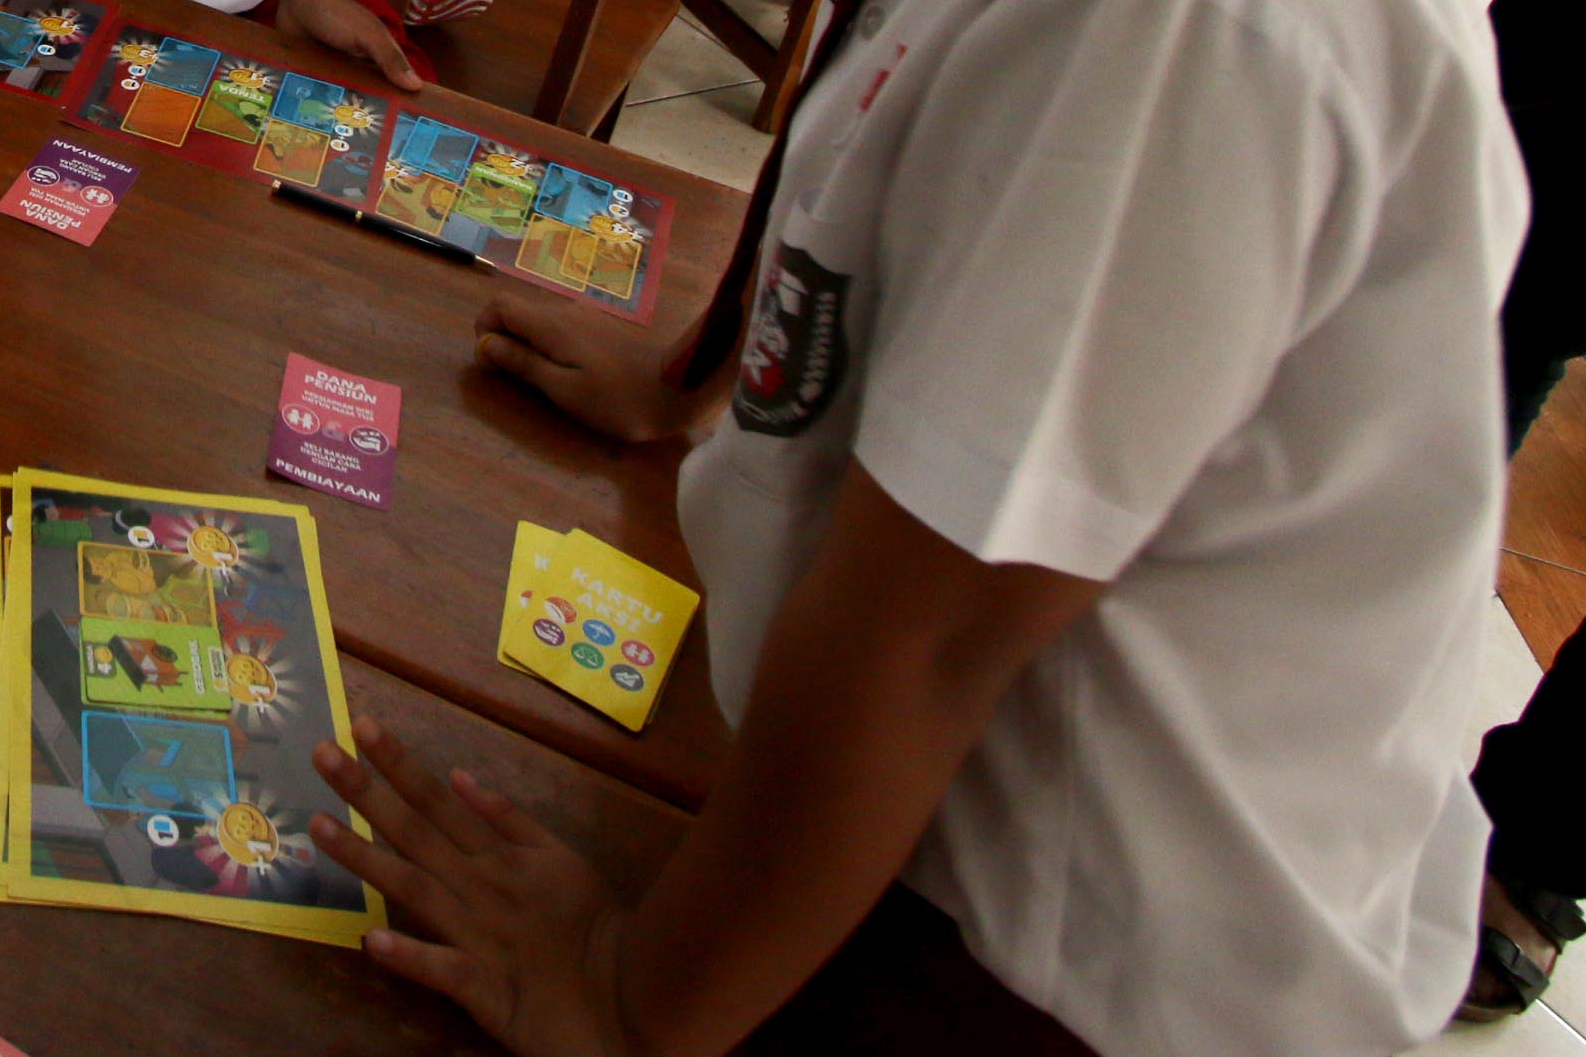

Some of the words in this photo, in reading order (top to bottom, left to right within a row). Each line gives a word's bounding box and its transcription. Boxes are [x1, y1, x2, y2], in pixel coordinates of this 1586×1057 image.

[215, 82, 267, 104] TENDA
[51, 139, 133, 173] PEMBIAYAAN
[17, 197, 83, 229] PENSIUN
[23, 206, 69, 230] DANA
[303, 373, 377, 406] PENSIUN
[316, 369, 366, 394] DANA
[274, 457, 382, 505] PEMBIAYAAN
[570, 566, 663, 624] KARTU
[575, 592, 643, 633] AKSI
